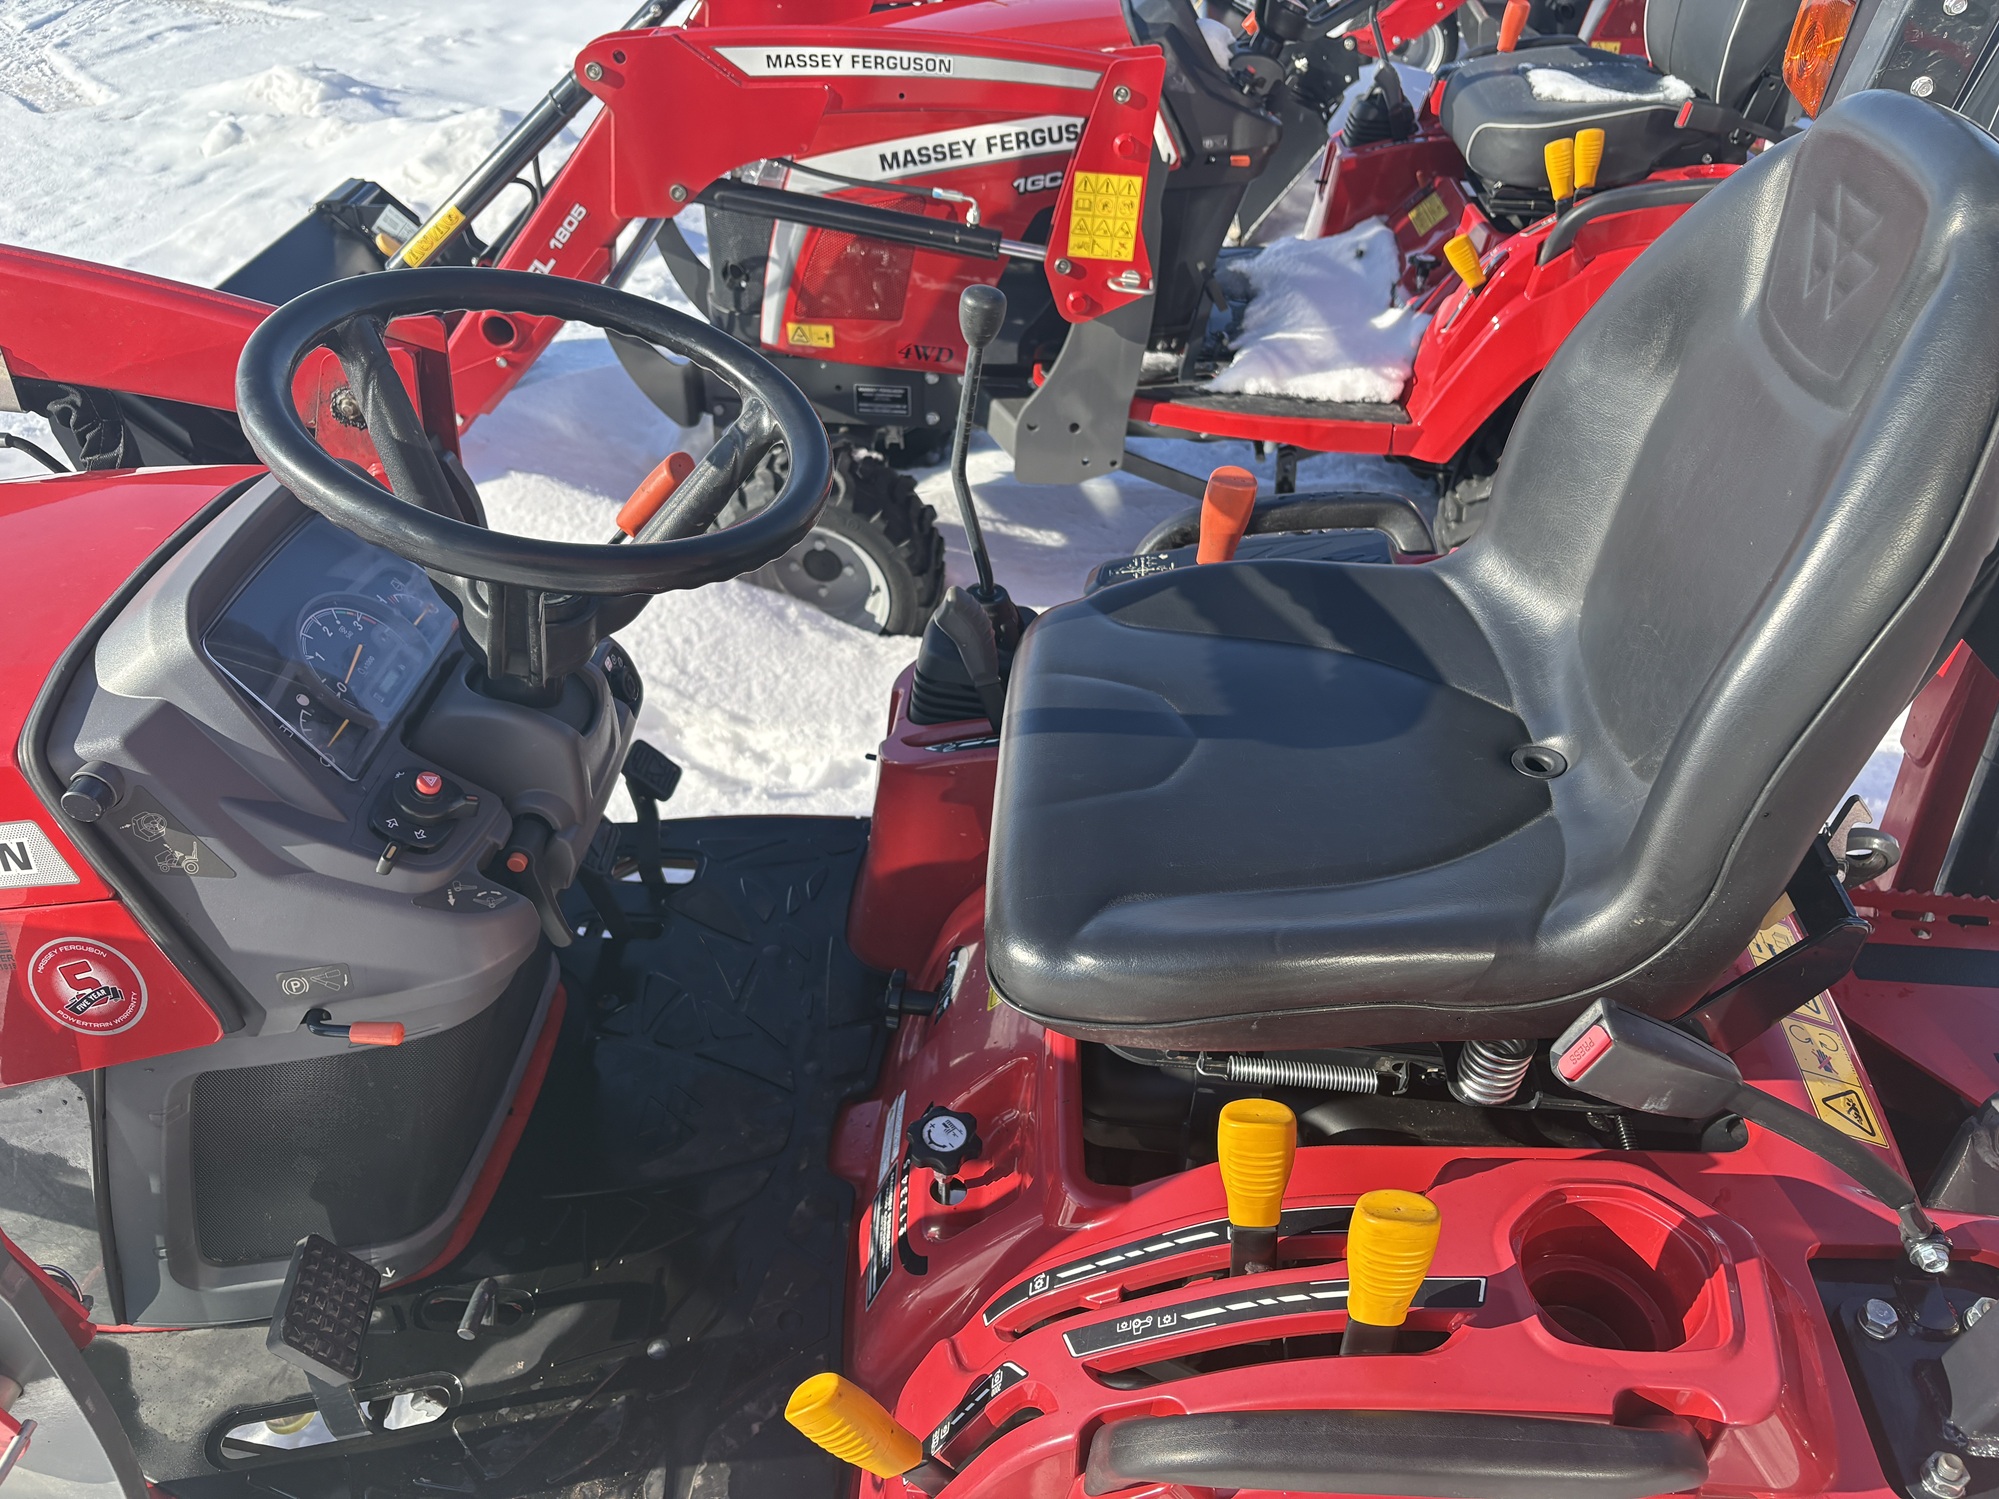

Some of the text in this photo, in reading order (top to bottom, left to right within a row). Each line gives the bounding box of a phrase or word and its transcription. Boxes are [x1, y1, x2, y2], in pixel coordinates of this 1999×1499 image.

[766, 54, 952, 73] MASSEY FERGUSON
[879, 123, 1087, 172] MASSEY FERGUS
[549, 202, 587, 250] 1805
[898, 343, 954, 363] 4WD
[37, 944, 108, 974] MASSEY FERGUSON
[57, 959, 109, 1008] 5
[56, 991, 138, 1028] POWERTRAIN WARRANTY
[75, 988, 107, 1012] FIVE YEAR
[1569, 1036, 1596, 1066] PRESS
